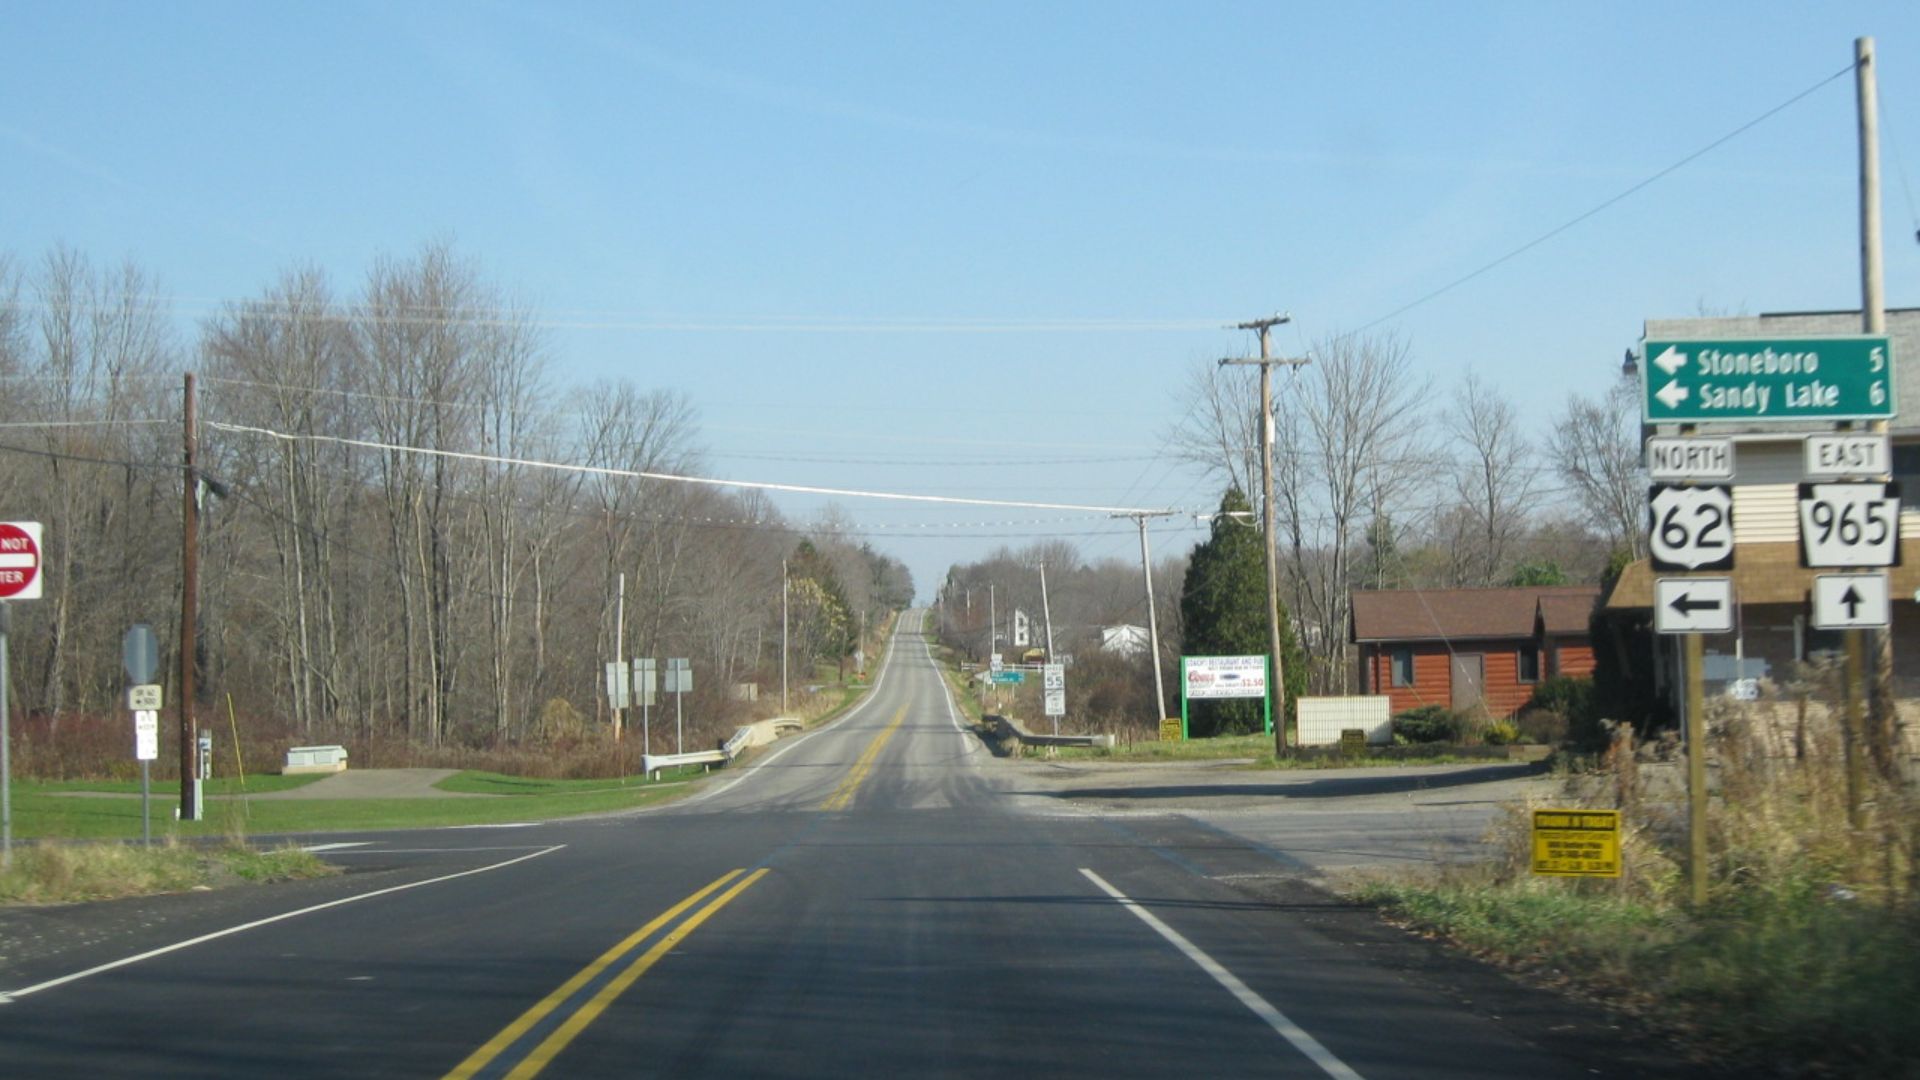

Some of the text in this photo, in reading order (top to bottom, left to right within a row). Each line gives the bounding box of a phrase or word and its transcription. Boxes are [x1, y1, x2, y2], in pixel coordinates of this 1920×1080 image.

[1698, 346, 1885, 376] Stoneboro 5
[1699, 379, 1886, 415] Sandy Lake 6
[1653, 445, 1726, 470] NORTH
[1819, 442, 1876, 467] EAST
[1660, 503, 1725, 549] 62
[1810, 500, 1888, 546] 965
[1, 537, 29, 551] NOT
[1047, 676, 1062, 687] 55
[1187, 670, 1216, 682] Coors
